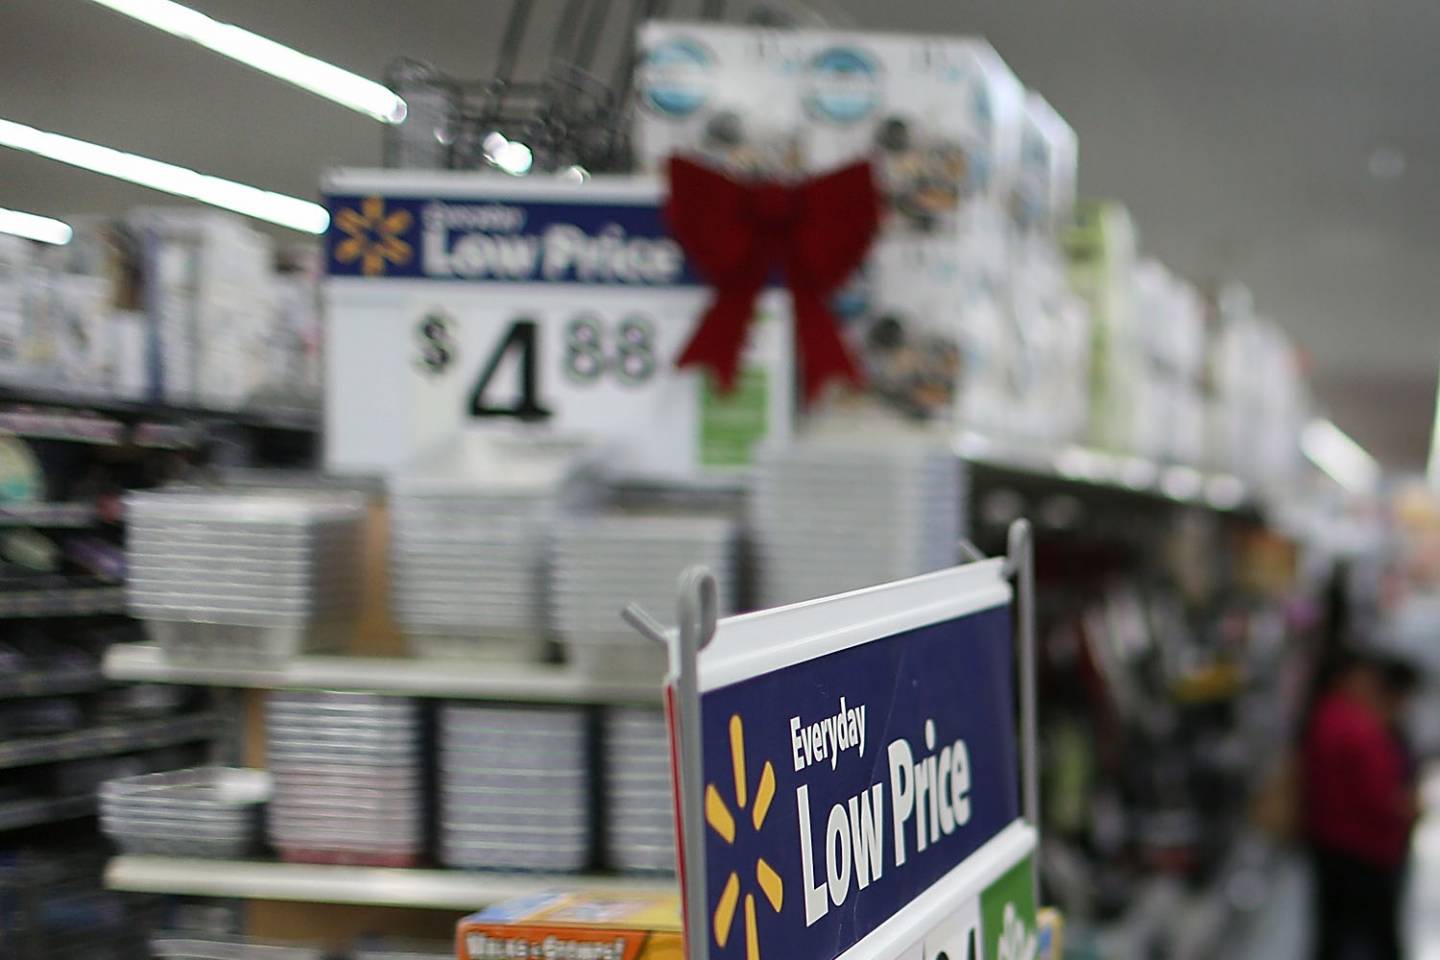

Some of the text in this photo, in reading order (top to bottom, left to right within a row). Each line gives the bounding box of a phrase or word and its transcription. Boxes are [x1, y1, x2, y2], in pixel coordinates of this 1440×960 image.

[421, 222, 687, 285] Low Price
[790, 696, 866, 772] Everyday
[796, 718, 972, 928] Low Price
